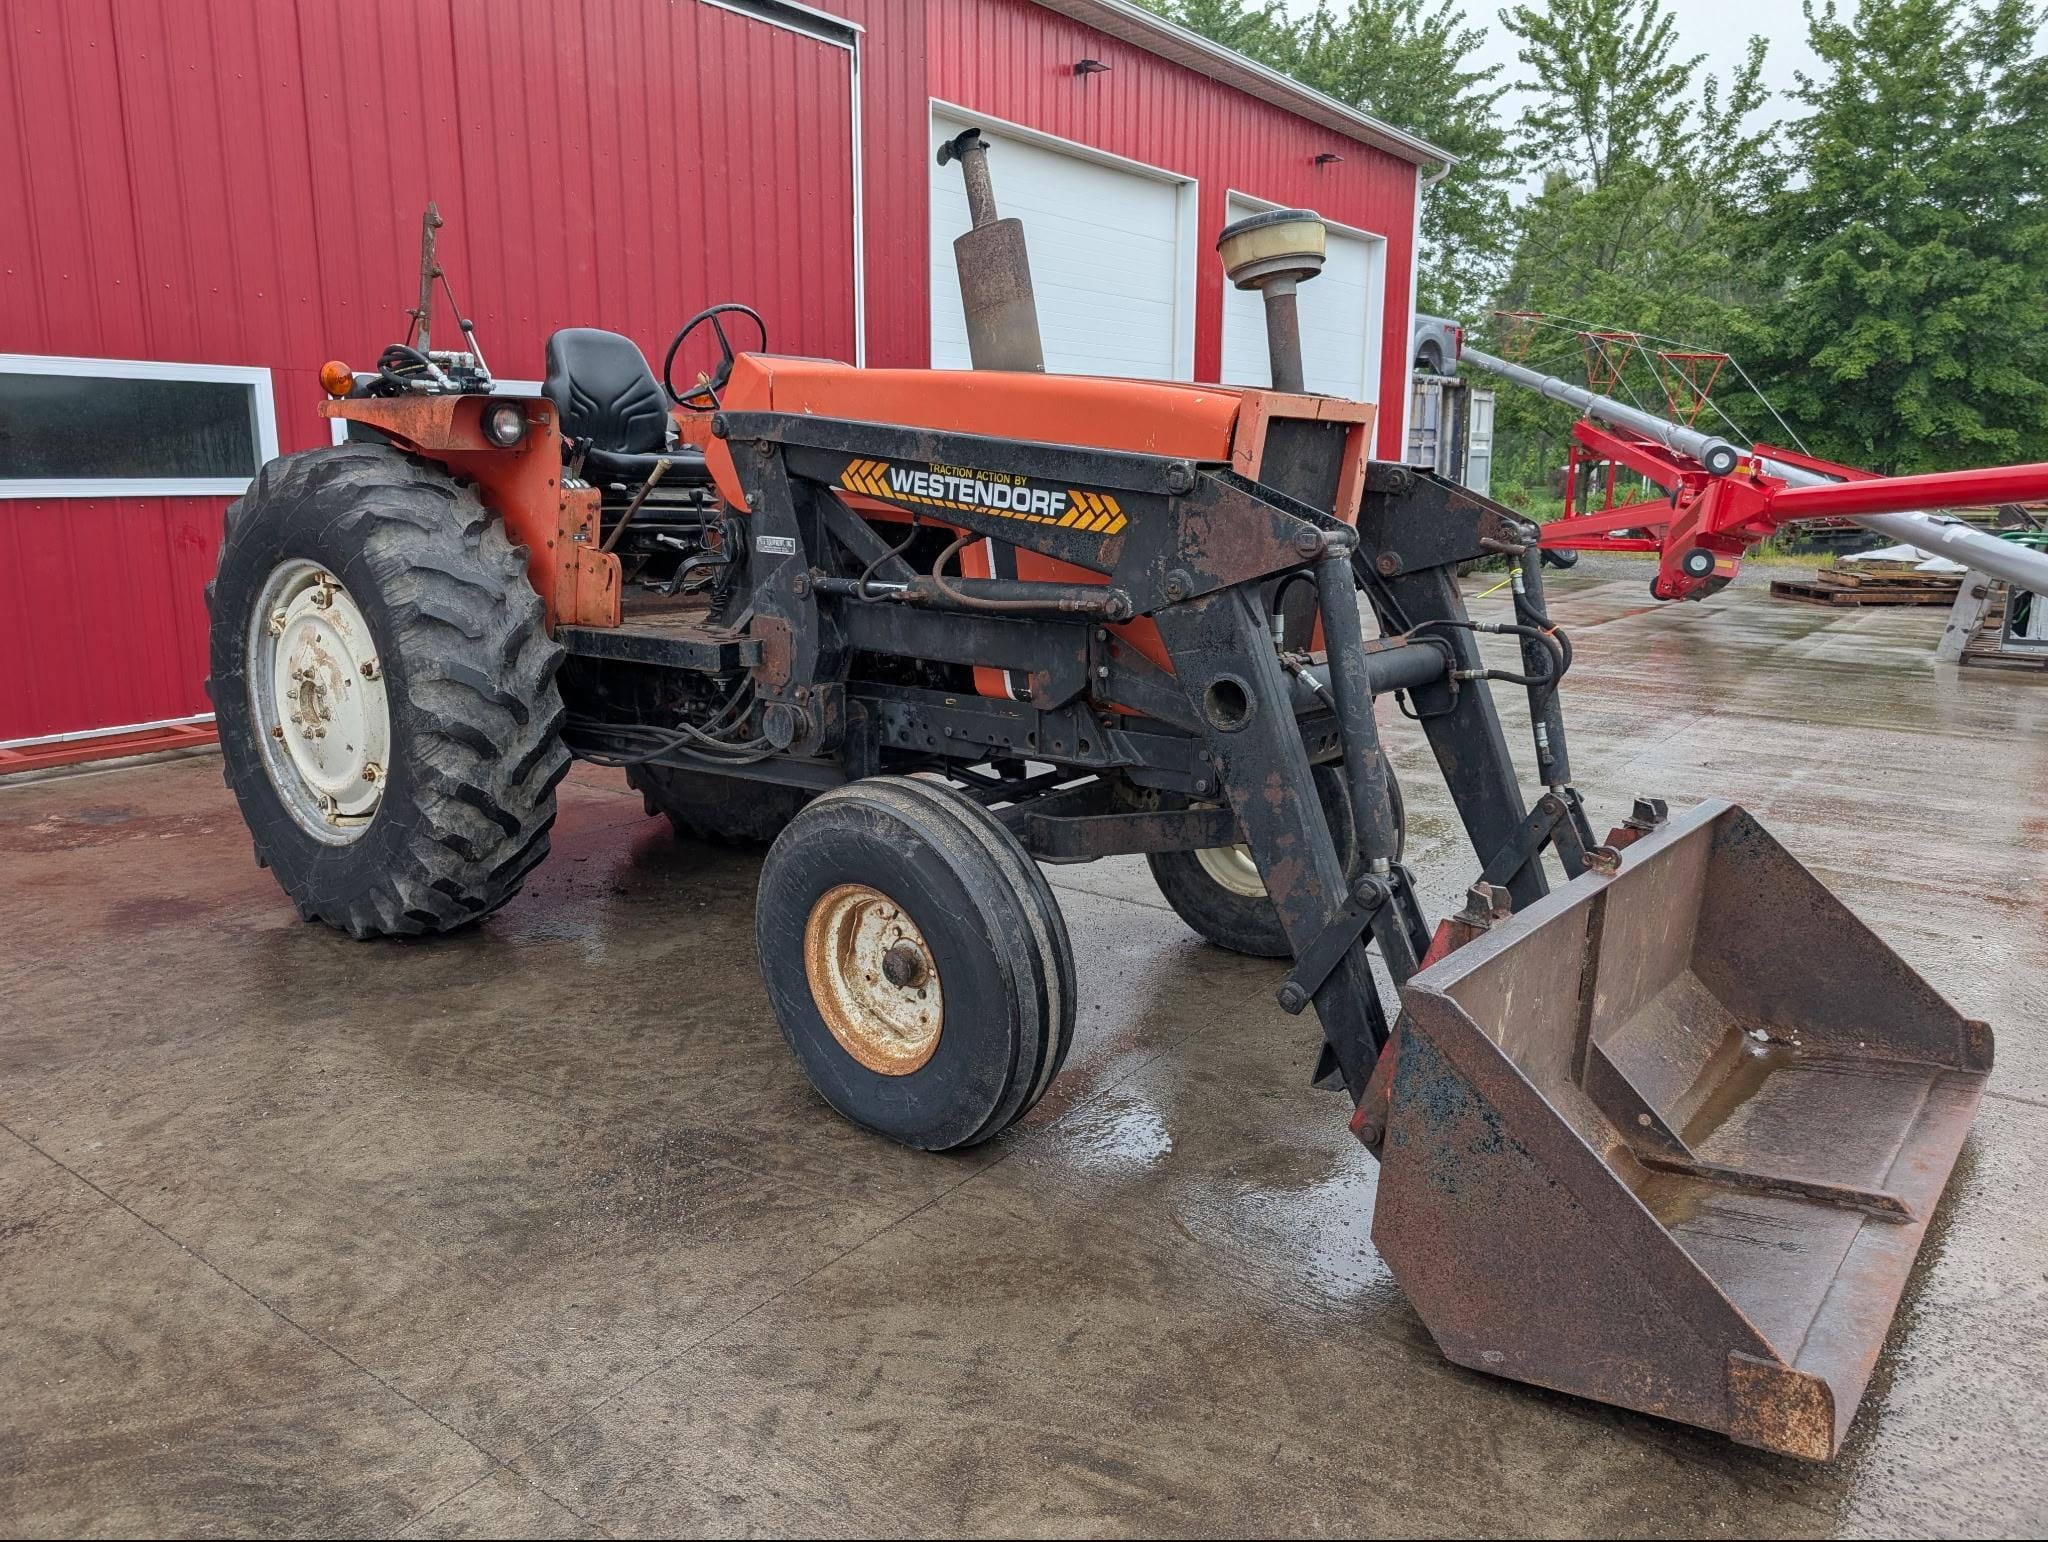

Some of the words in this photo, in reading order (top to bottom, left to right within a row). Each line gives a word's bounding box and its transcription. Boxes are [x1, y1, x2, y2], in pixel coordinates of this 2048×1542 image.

[890, 467, 1067, 517] WESTENDORF
[928, 462, 973, 479] TRACTION
[976, 468, 1011, 484] ACTION
[1014, 475, 1028, 487] BY
